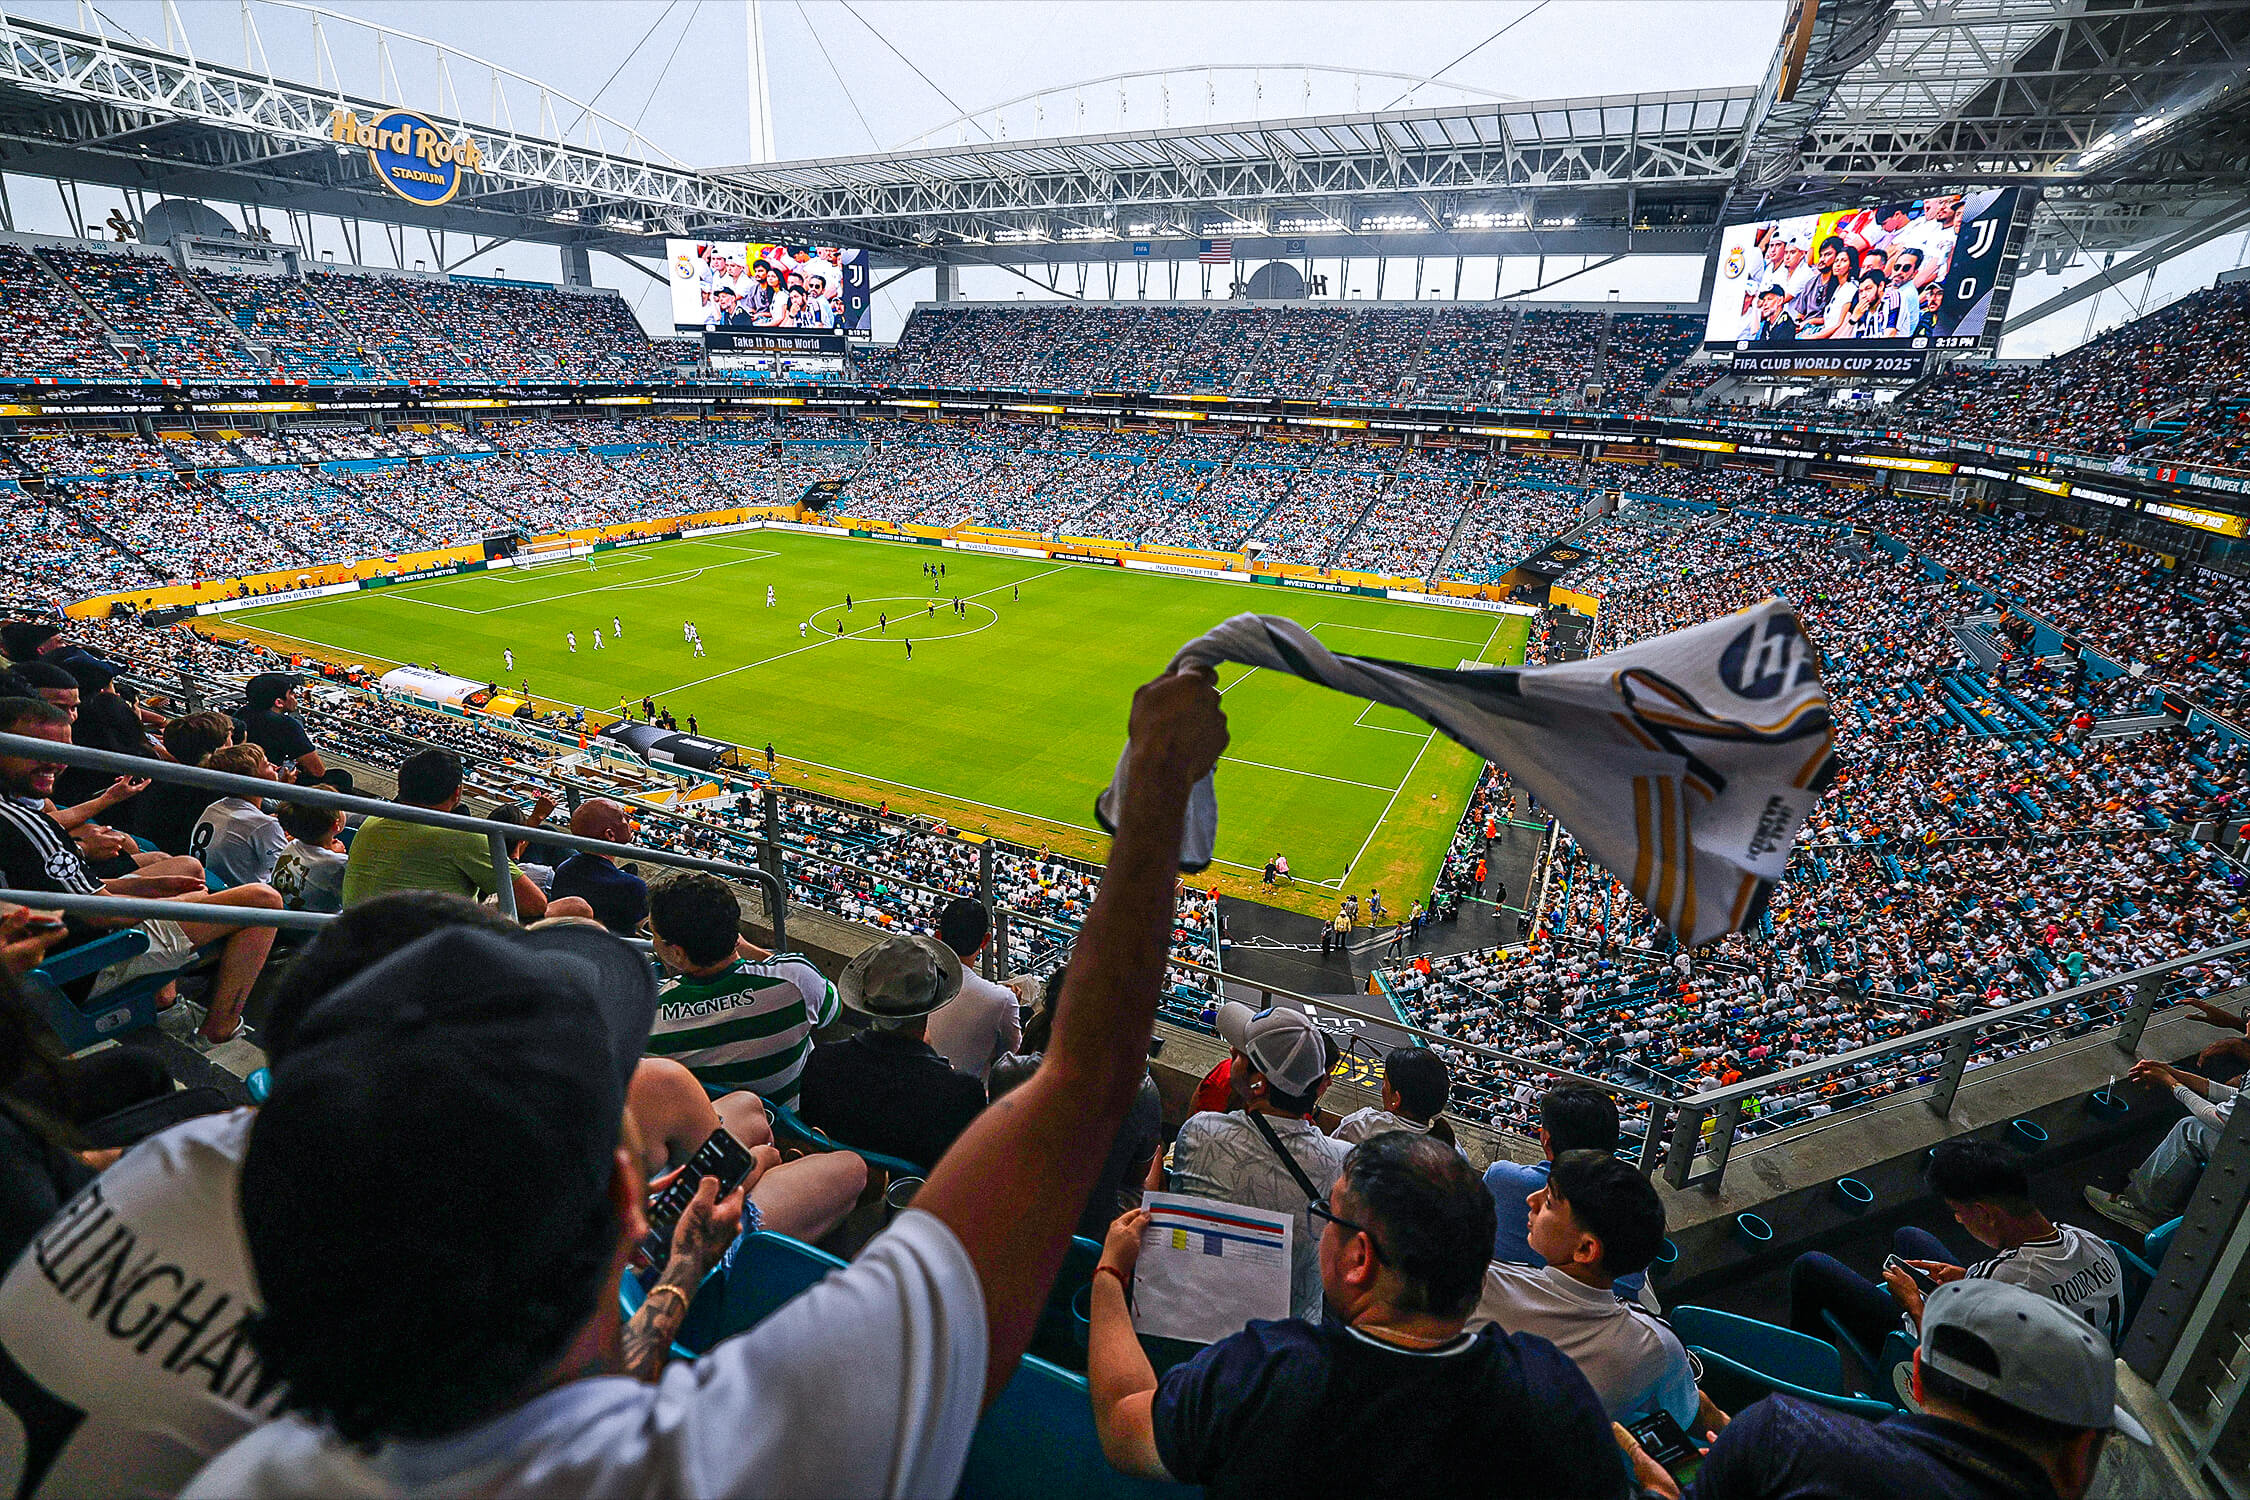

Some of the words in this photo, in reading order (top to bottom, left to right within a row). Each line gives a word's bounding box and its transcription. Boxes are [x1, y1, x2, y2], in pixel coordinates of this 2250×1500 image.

[330, 110, 412, 155] Hard
[414, 127, 485, 175] Rock
[391, 166, 446, 185] STADIUM
[91, 242, 108, 250] 303
[228, 265, 243, 273] 304
[732, 336, 754, 348] Take
[764, 337, 775, 348] To
[776, 338, 793, 349] The
[795, 338, 820, 350] World
[1935, 337, 1960, 348] 3:13
[1961, 336, 1974, 347] PM
[1733, 358, 1758, 370] FIFA
[1760, 358, 1790, 371] CLUB
[1793, 357, 1841, 370] WORLD
[1844, 357, 1872, 370] CUP
[2213, 476, 2240, 493] DUPER
[1284, 579, 1316, 589] INVESTED
[1325, 584, 1351, 593] BETTER
[240, 595, 281, 607] INVESTED
[293, 589, 323, 598] BETTER
[1423, 596, 1460, 605] INVESTED
[1472, 601, 1501, 610] BETTER
[661, 988, 756, 1021] MAGNERS
[2050, 1256, 2117, 1306] RODRYGO
